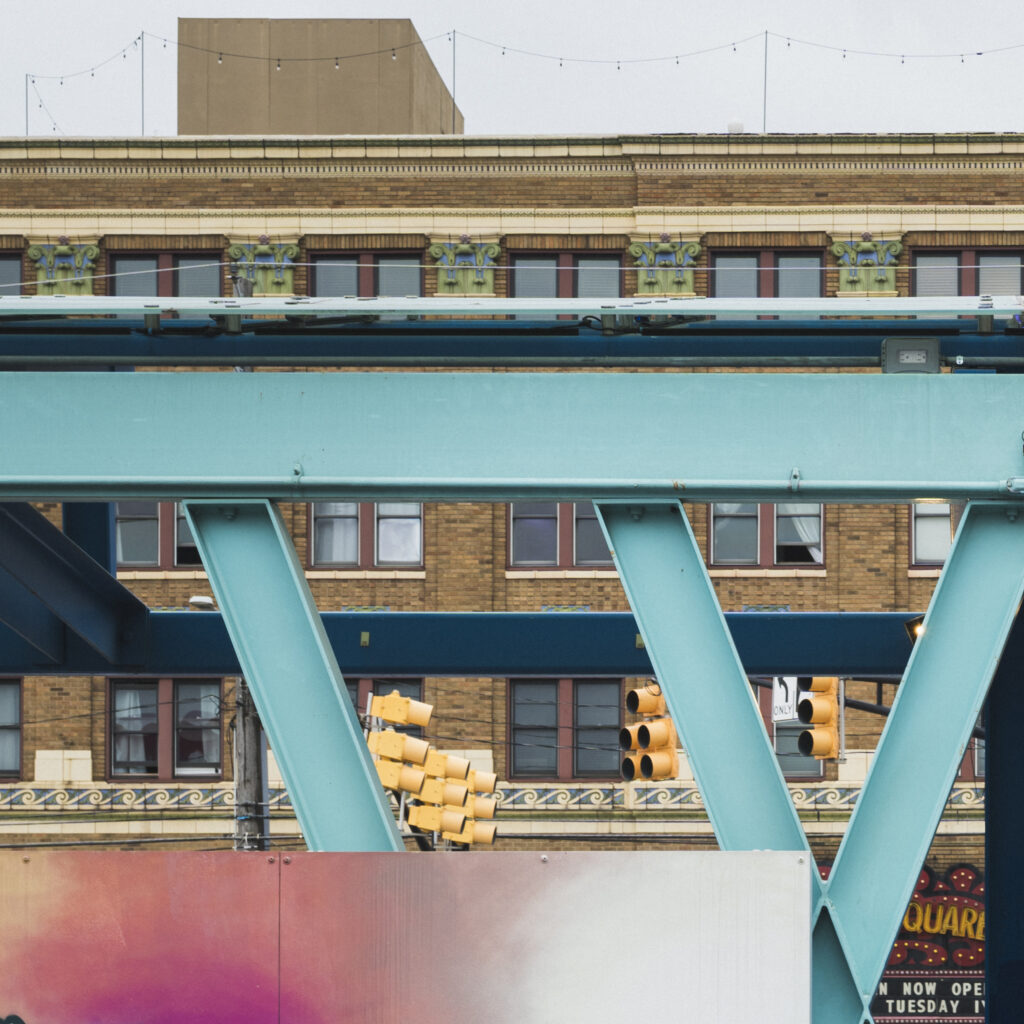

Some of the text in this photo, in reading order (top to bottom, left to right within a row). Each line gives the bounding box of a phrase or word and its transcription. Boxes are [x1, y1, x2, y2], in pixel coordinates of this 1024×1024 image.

[875, 982, 985, 996] N NOW OPE
[886, 999, 959, 1014] TUESDAY
